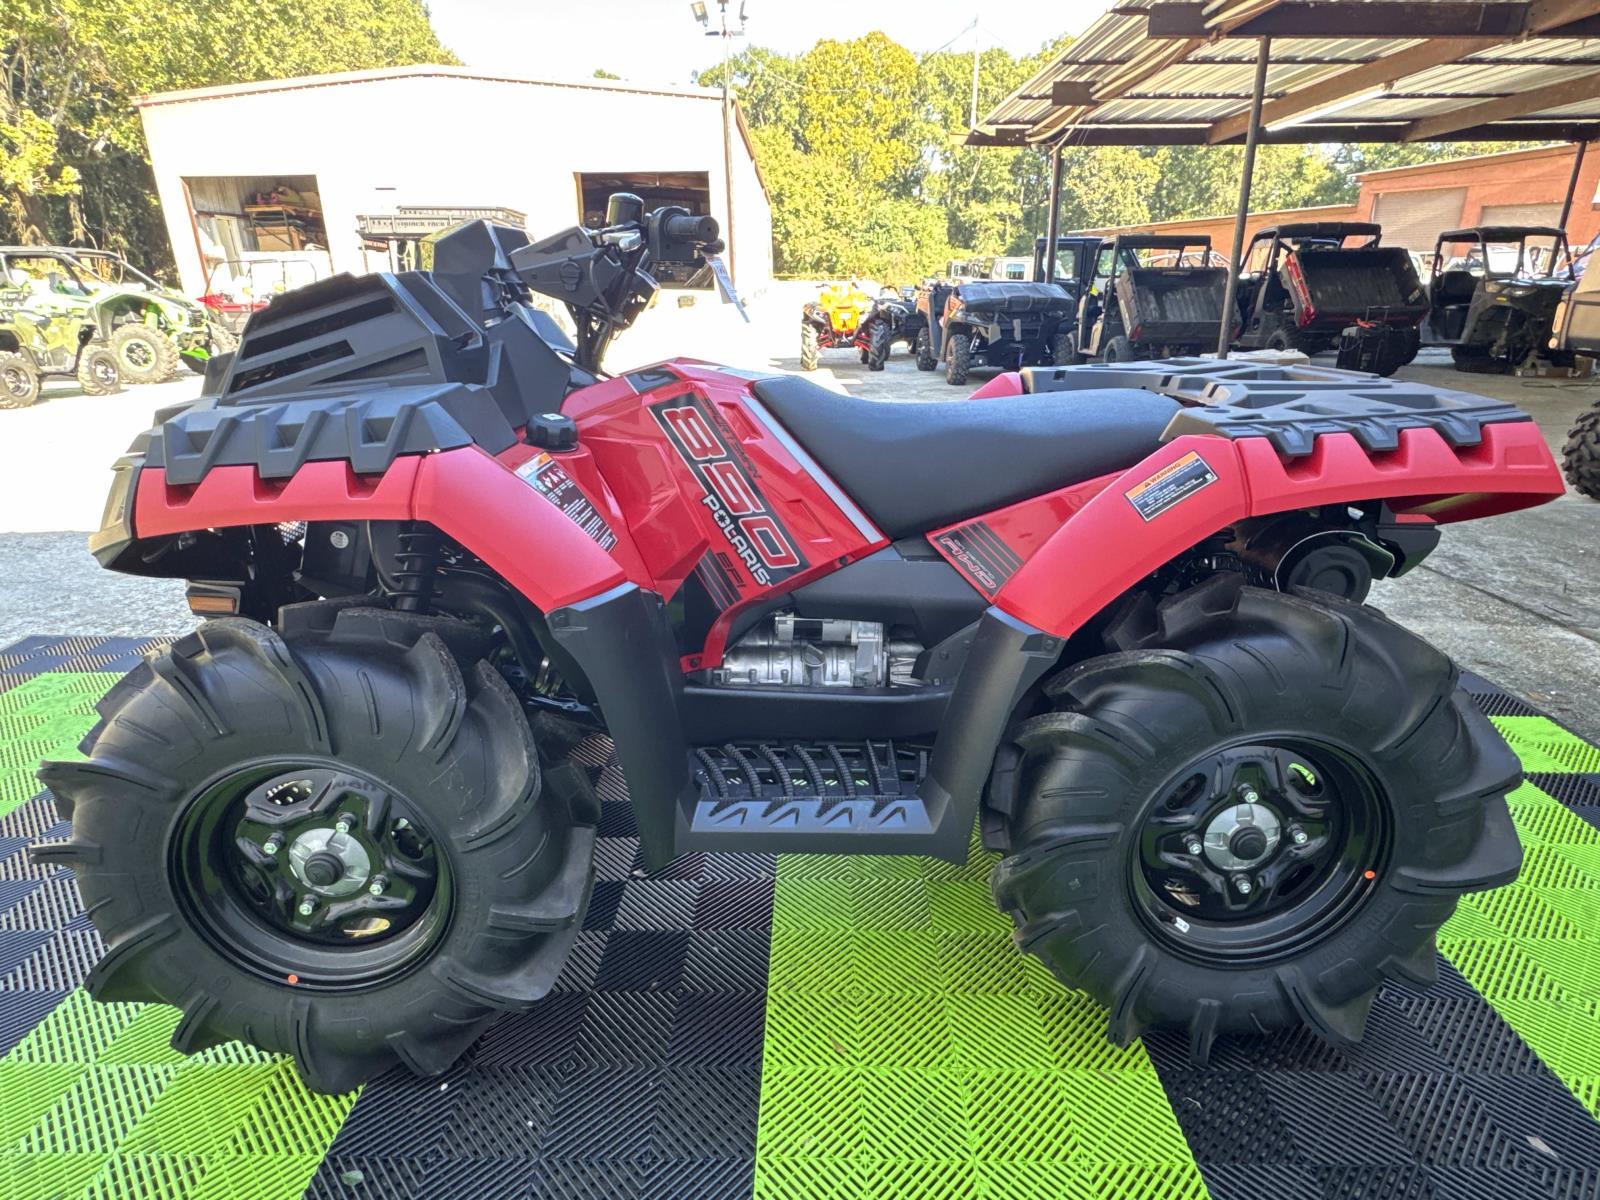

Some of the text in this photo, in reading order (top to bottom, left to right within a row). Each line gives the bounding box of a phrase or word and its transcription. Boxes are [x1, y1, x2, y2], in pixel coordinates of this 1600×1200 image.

[662, 405, 799, 569] 850
[1150, 463, 1181, 483] WARNING
[701, 494, 771, 586] POLARIS
[940, 537, 997, 589] AWD
[716, 552, 746, 587] EFI
